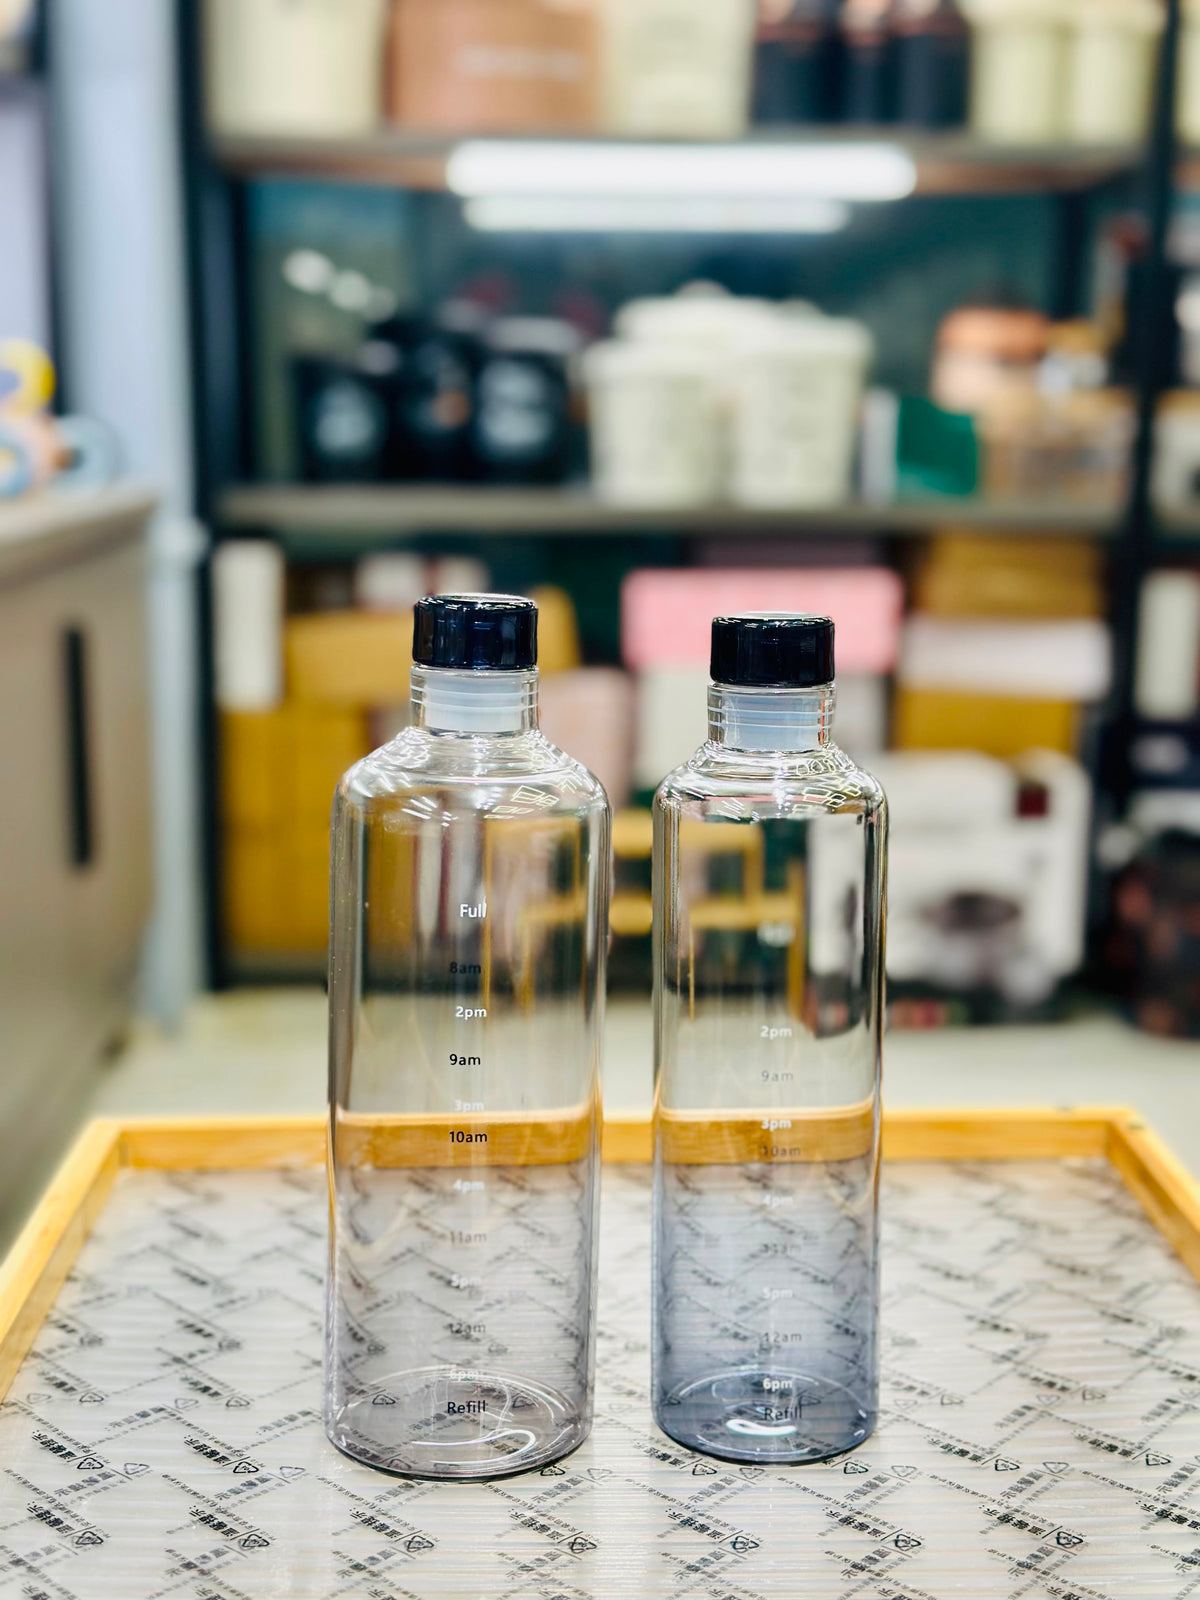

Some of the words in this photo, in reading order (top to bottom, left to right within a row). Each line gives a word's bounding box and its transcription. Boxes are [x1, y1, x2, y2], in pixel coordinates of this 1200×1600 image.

[459, 902, 487, 918] Full
[449, 961, 481, 974] 8am
[455, 1006, 487, 1021] 2pm
[760, 1025, 792, 1040] 2pm
[449, 1054, 481, 1066] 9am
[761, 1070, 794, 1082] 9am
[454, 1099, 485, 1113] 3pm
[761, 1117, 792, 1132] 3pm
[449, 1131, 488, 1143] 10am
[762, 1145, 800, 1157] 10am
[453, 1179, 485, 1193] 4pm
[763, 1194, 794, 1209] 4pm
[762, 1288, 794, 1301] 5pm
[762, 1332, 802, 1344] 12am
[762, 1377, 794, 1392] 6pm
[447, 1400, 487, 1414] Refill
[764, 1406, 802, 1421] Refill
